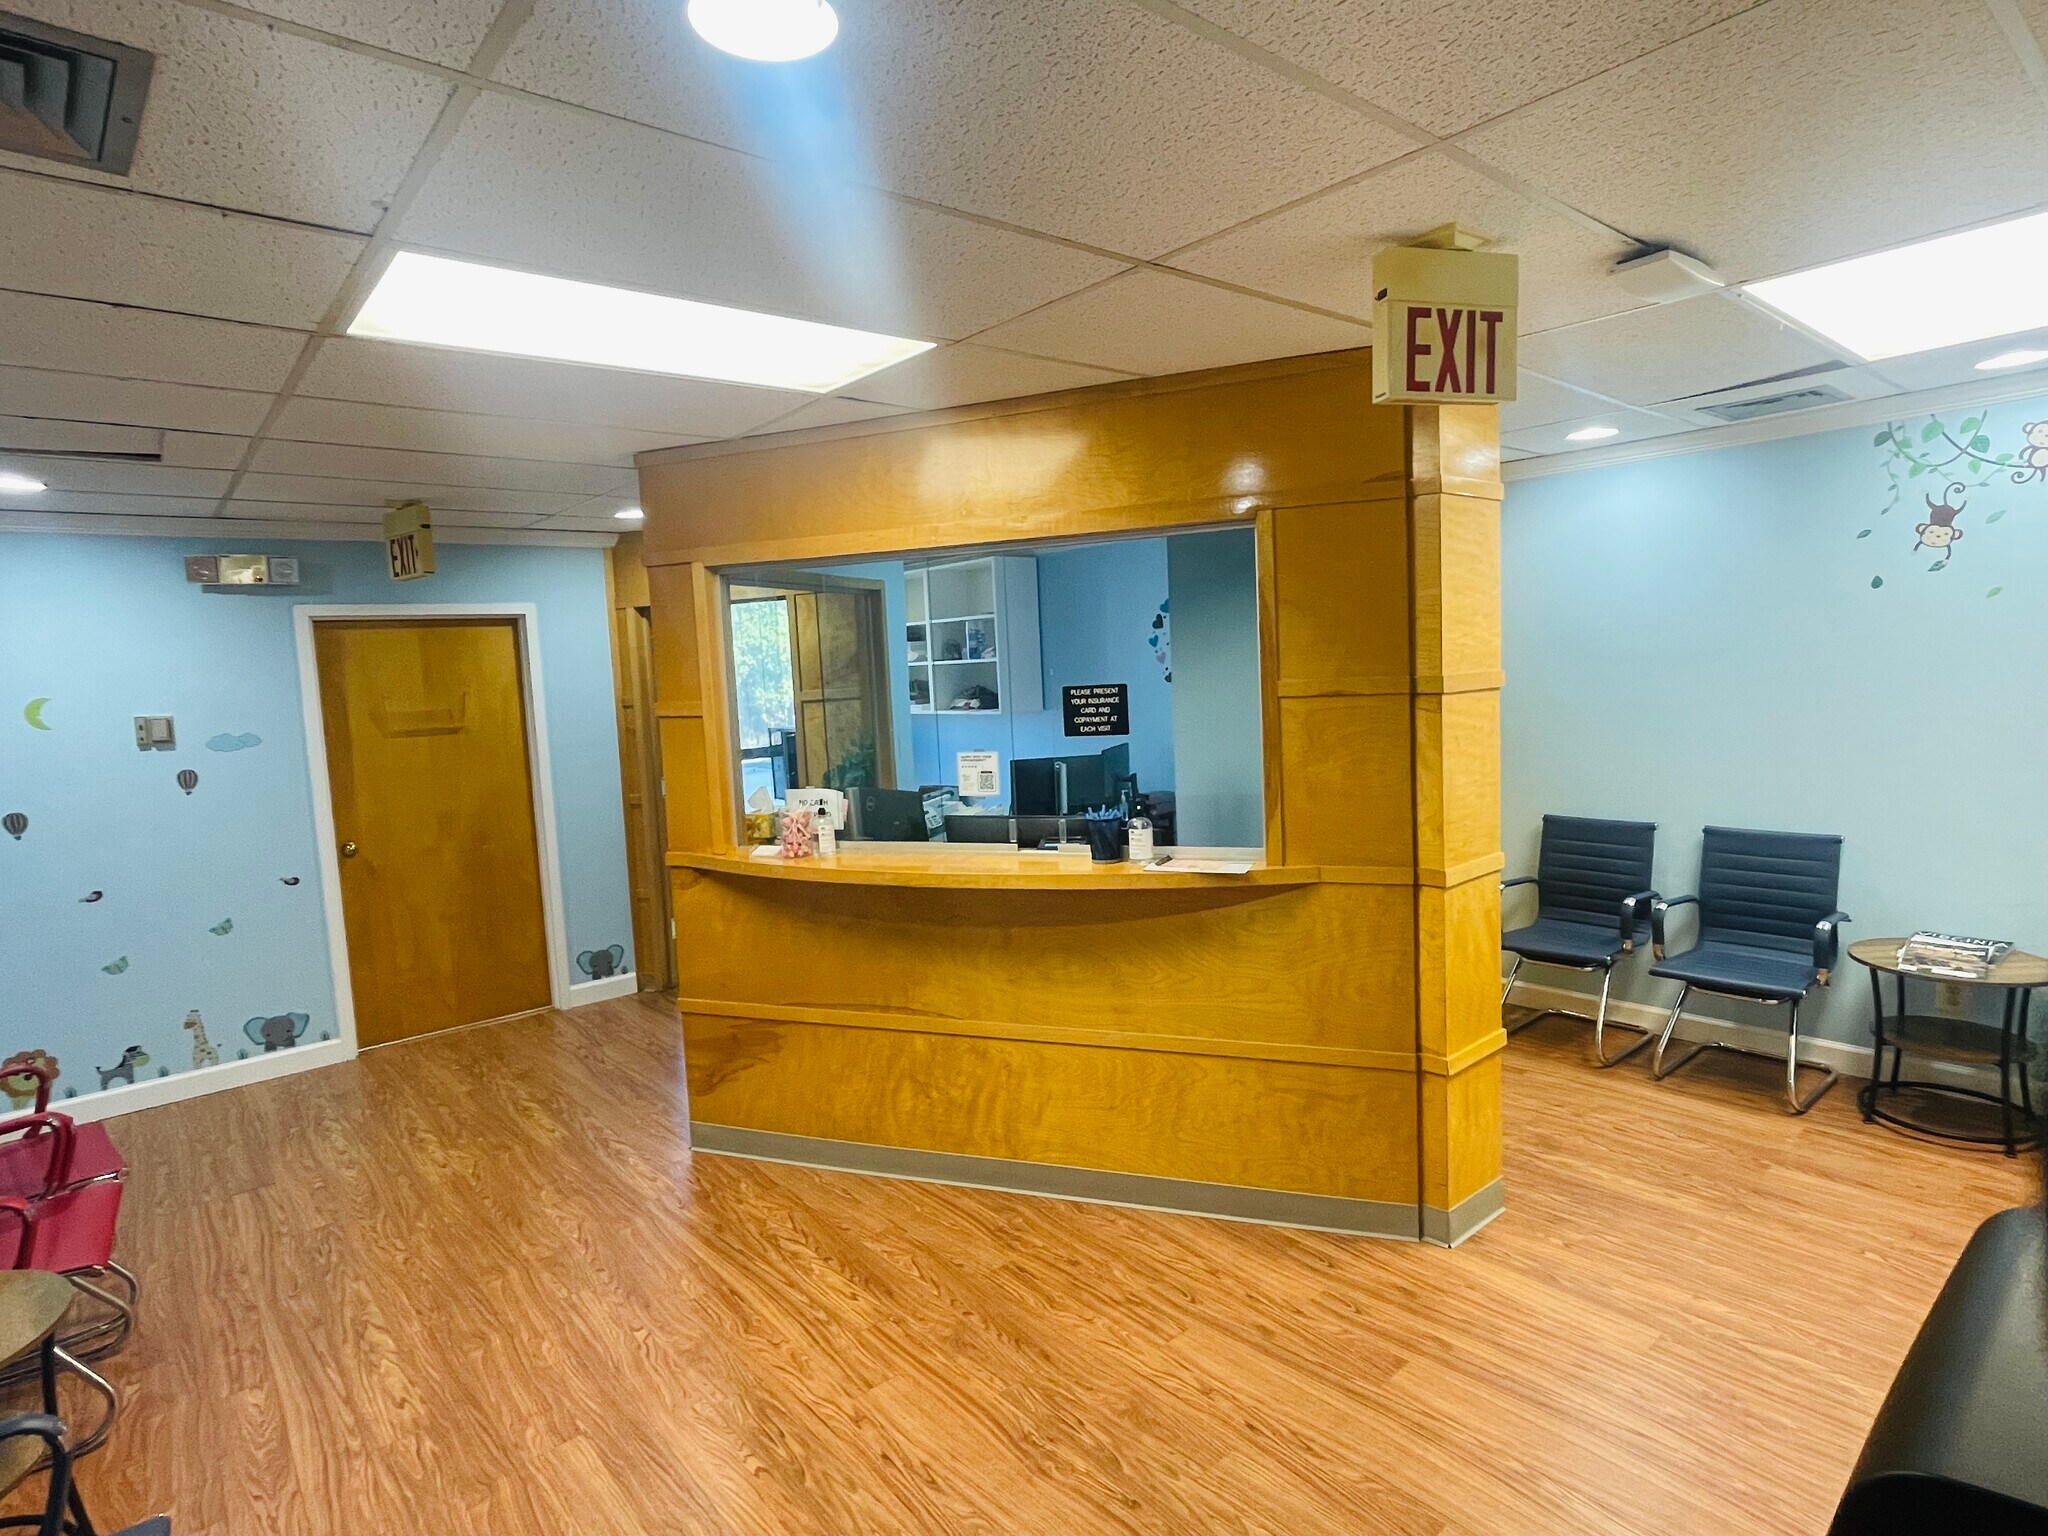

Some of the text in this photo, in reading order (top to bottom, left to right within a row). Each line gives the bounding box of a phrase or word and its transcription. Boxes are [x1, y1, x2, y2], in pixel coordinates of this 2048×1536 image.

[1406, 305, 1504, 395] EXIT
[389, 533, 417, 578] EXIT
[810, 798, 829, 806] CAH
